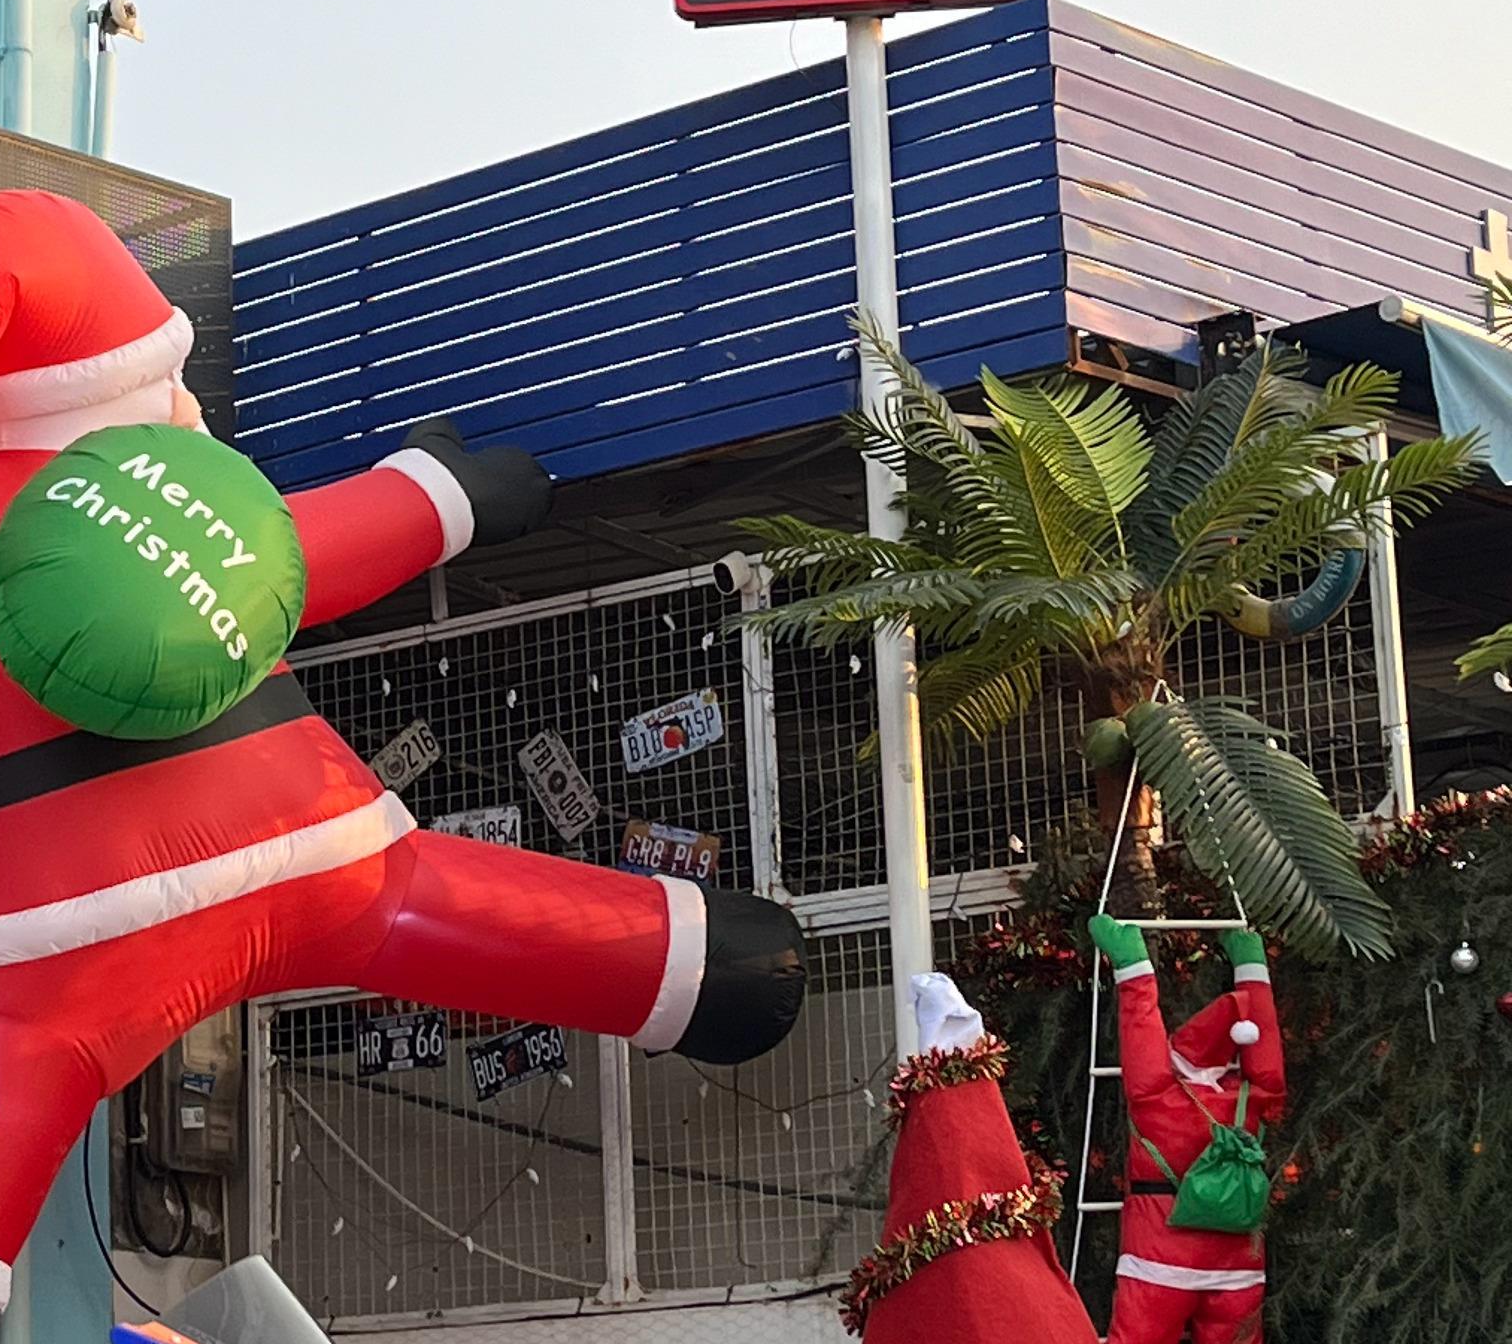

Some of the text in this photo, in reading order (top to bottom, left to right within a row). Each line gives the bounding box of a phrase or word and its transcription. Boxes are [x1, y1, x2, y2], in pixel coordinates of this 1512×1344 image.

[118, 453, 257, 570] Merry
[45, 475, 249, 662] Christmas
[359, 1022, 443, 1066] HR 66
[473, 1027, 562, 1089] BUS 1956
